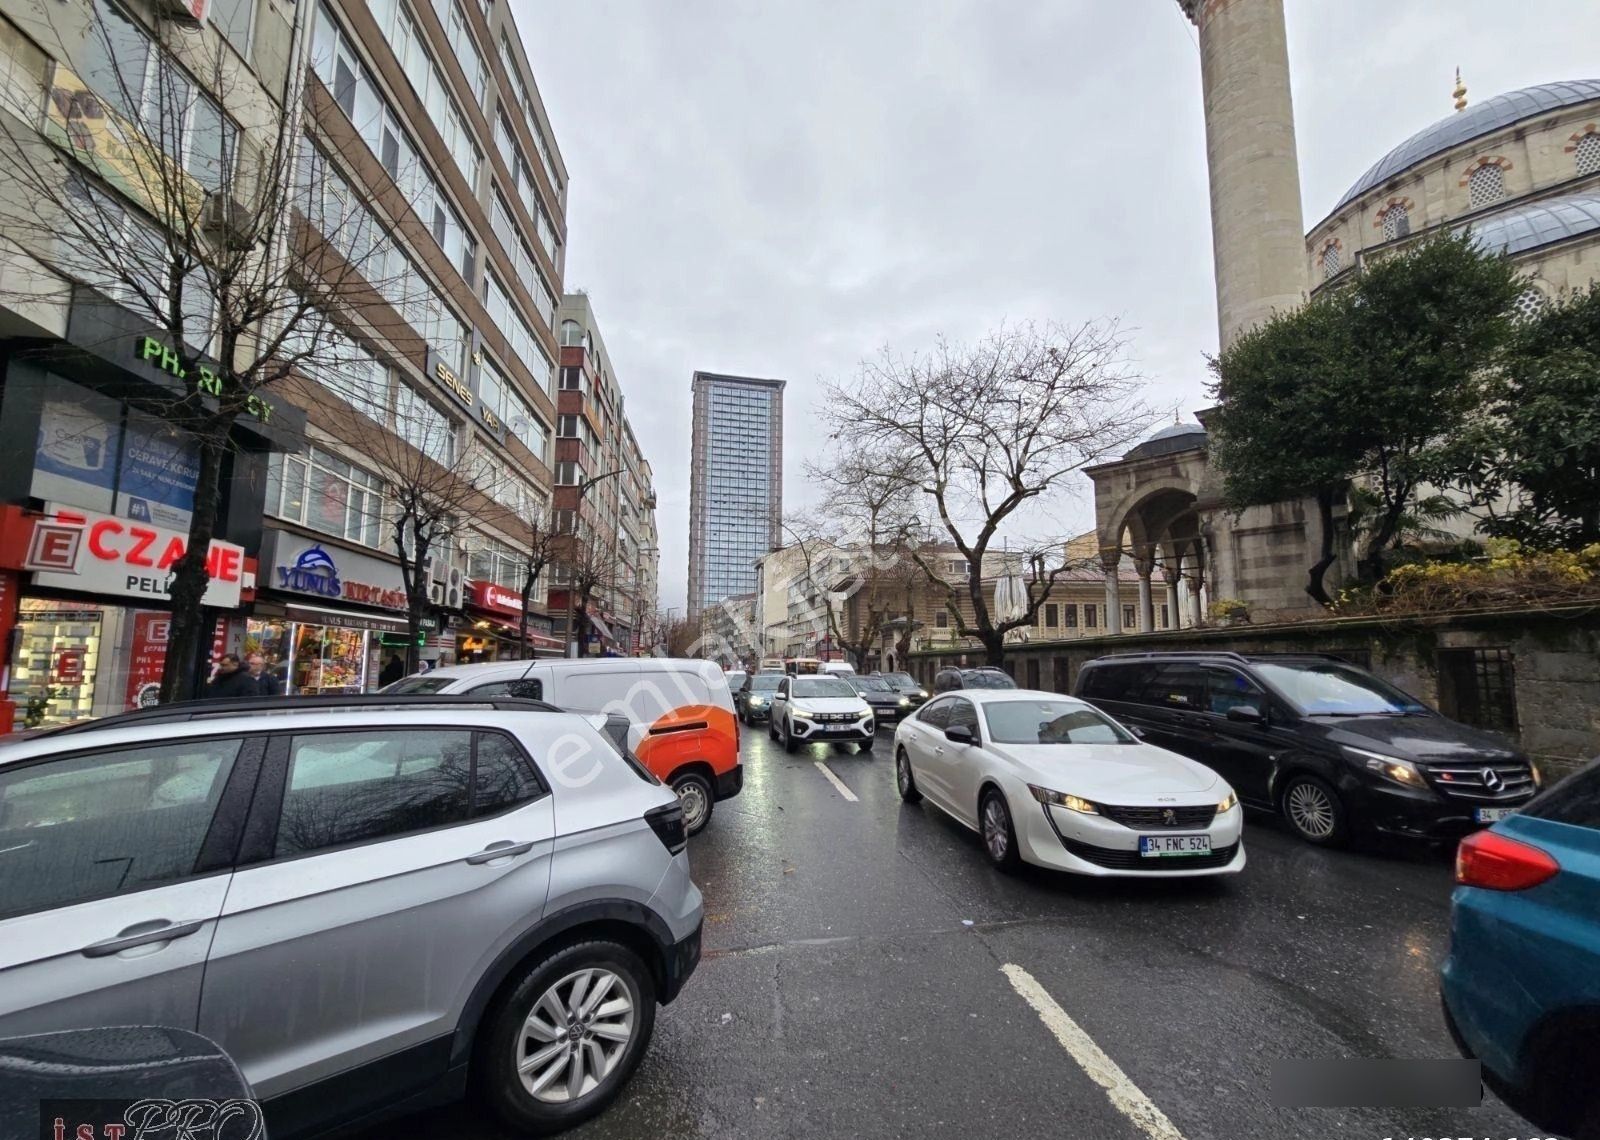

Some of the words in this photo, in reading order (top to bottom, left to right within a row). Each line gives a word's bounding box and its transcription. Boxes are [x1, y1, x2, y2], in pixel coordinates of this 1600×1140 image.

[436, 362, 473, 407] SENES
[131, 503, 145, 517] #1
[277, 566, 341, 597] YUNUS
[1148, 838, 1161, 852] 34
[1166, 838, 1185, 852] FNC
[1189, 837, 1208, 851] 524
